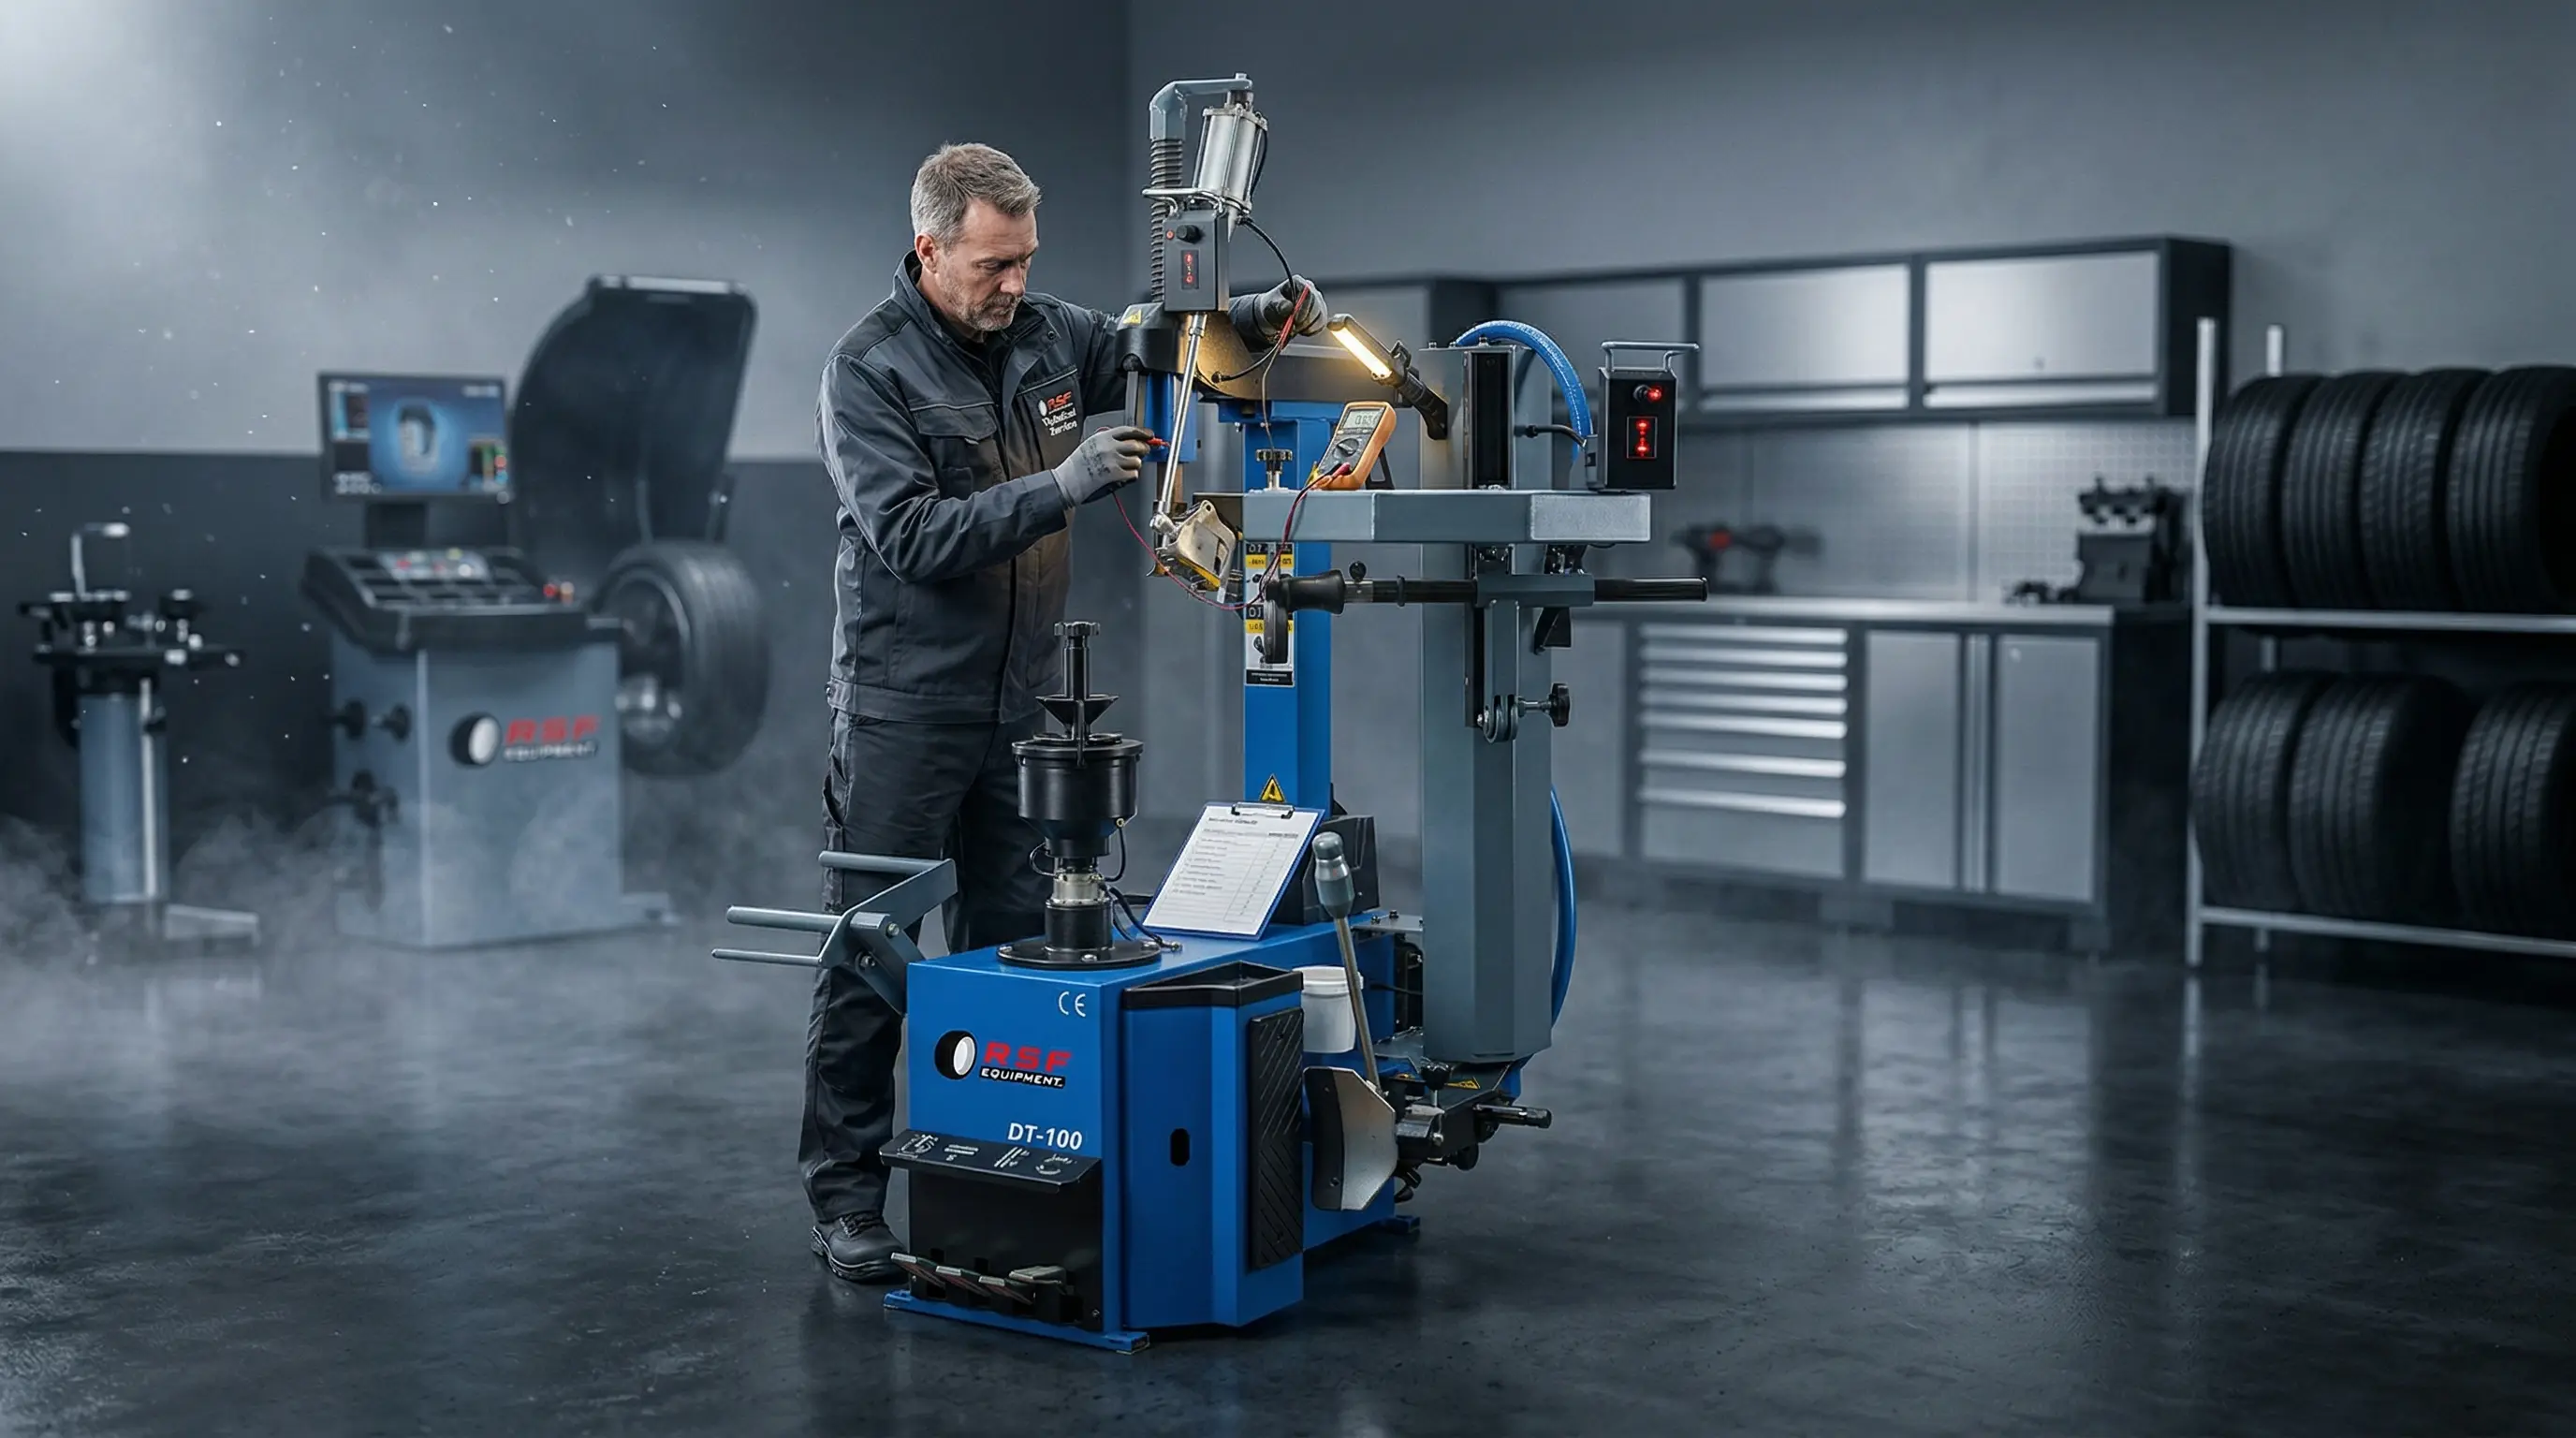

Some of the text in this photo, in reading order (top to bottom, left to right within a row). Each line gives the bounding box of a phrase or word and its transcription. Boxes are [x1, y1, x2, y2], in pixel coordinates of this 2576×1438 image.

[505, 715, 600, 745] RSF
[1058, 990, 1086, 1017] CE
[984, 1041, 1072, 1073] RSF
[1007, 1123, 1083, 1151] DT-100
